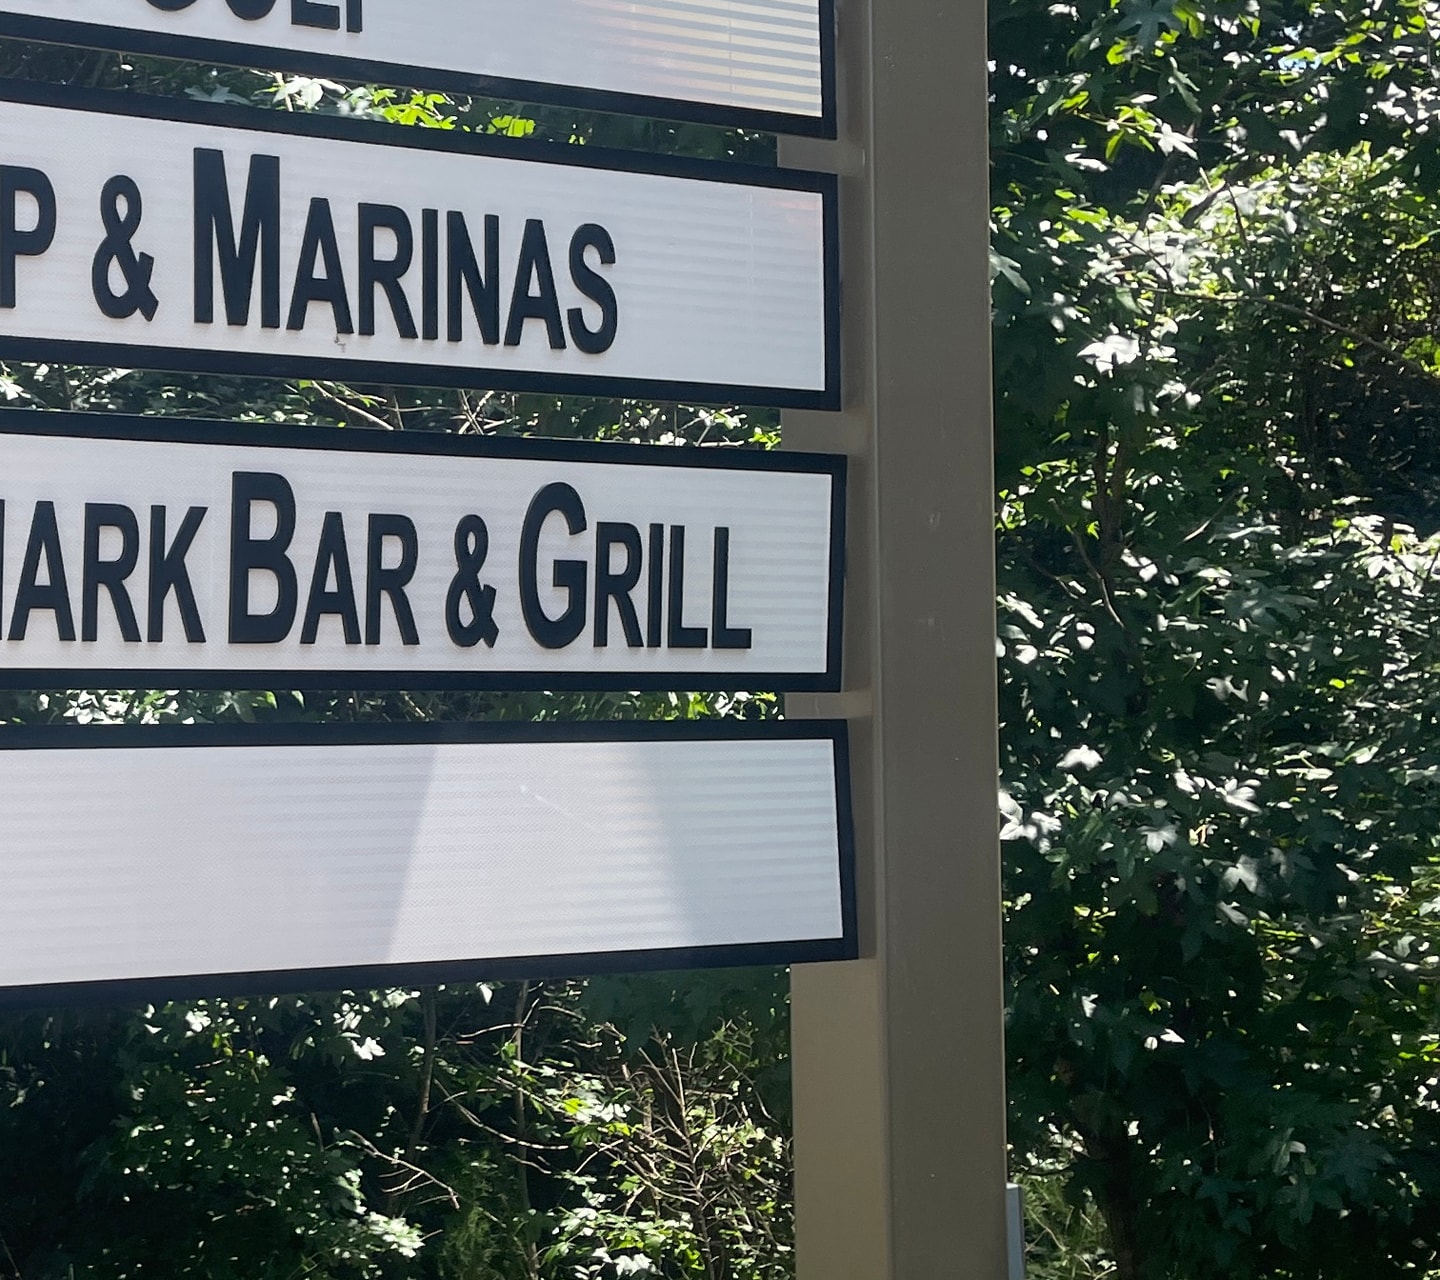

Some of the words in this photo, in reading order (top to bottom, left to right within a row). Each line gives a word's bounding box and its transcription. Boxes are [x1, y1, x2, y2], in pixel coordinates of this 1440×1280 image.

[92, 175, 158, 322] &
[194, 148, 617, 354] MARINAS
[228, 471, 420, 645] BAR
[446, 514, 499, 648] &
[519, 482, 752, 649] GRILL
